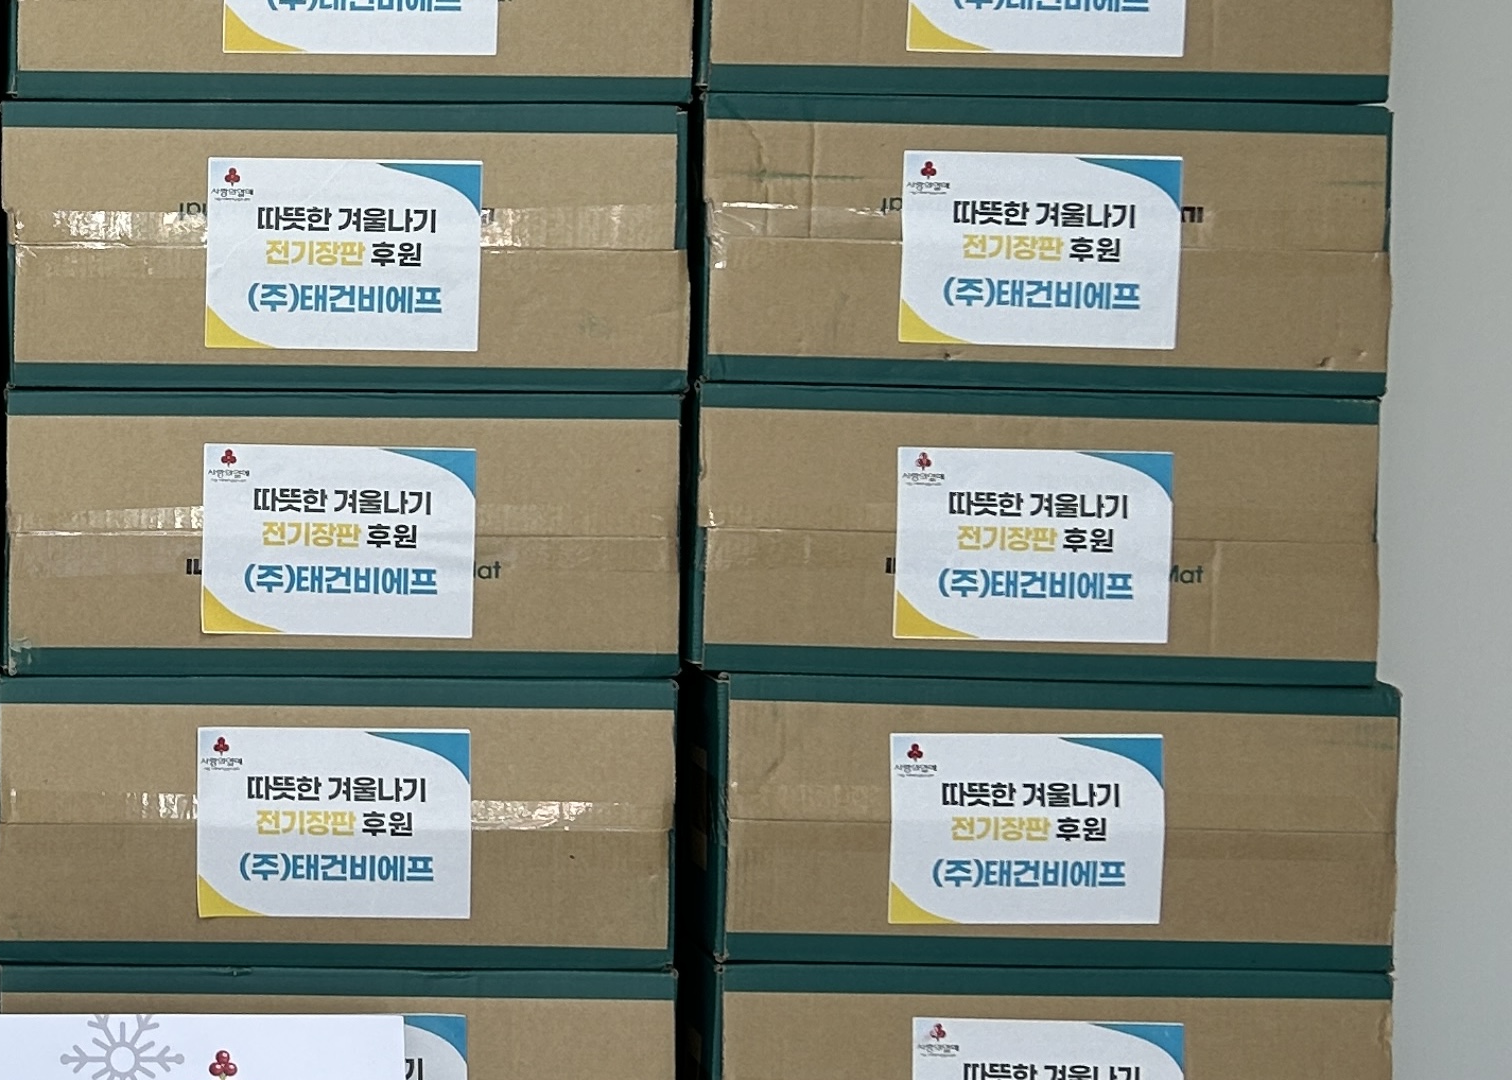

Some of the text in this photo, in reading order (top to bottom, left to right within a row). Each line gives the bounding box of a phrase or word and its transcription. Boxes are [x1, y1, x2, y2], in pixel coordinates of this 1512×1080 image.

[257, 206, 437, 234] 따뜻한 겨울나기
[953, 200, 1136, 229] 따뜻한 겨울나기
[265, 240, 422, 267] 전기장판 후원
[963, 234, 1121, 263] 전기장판 후원
[247, 283, 442, 314] (주)태건비에프
[943, 277, 1140, 311] (주)태건비에프
[253, 487, 432, 516] 따뜻한 겨울나기
[948, 491, 1128, 520] 따뜻한 겨울나기
[261, 521, 417, 549] 전기장판 후원
[957, 525, 1114, 553] 전기장판 후원
[243, 564, 437, 596] (주)태건비에프
[938, 568, 1133, 600] (주)태건비에프
[247, 775, 426, 803] 따뜻한 겨울나기
[941, 782, 1120, 808] 따뜻한 겨울나기
[256, 810, 413, 837] 전기장판 후원
[951, 816, 1107, 842] 전기장판 후원
[239, 852, 434, 882] (주)태건비에프
[931, 858, 1125, 888] (주)태건비에프
